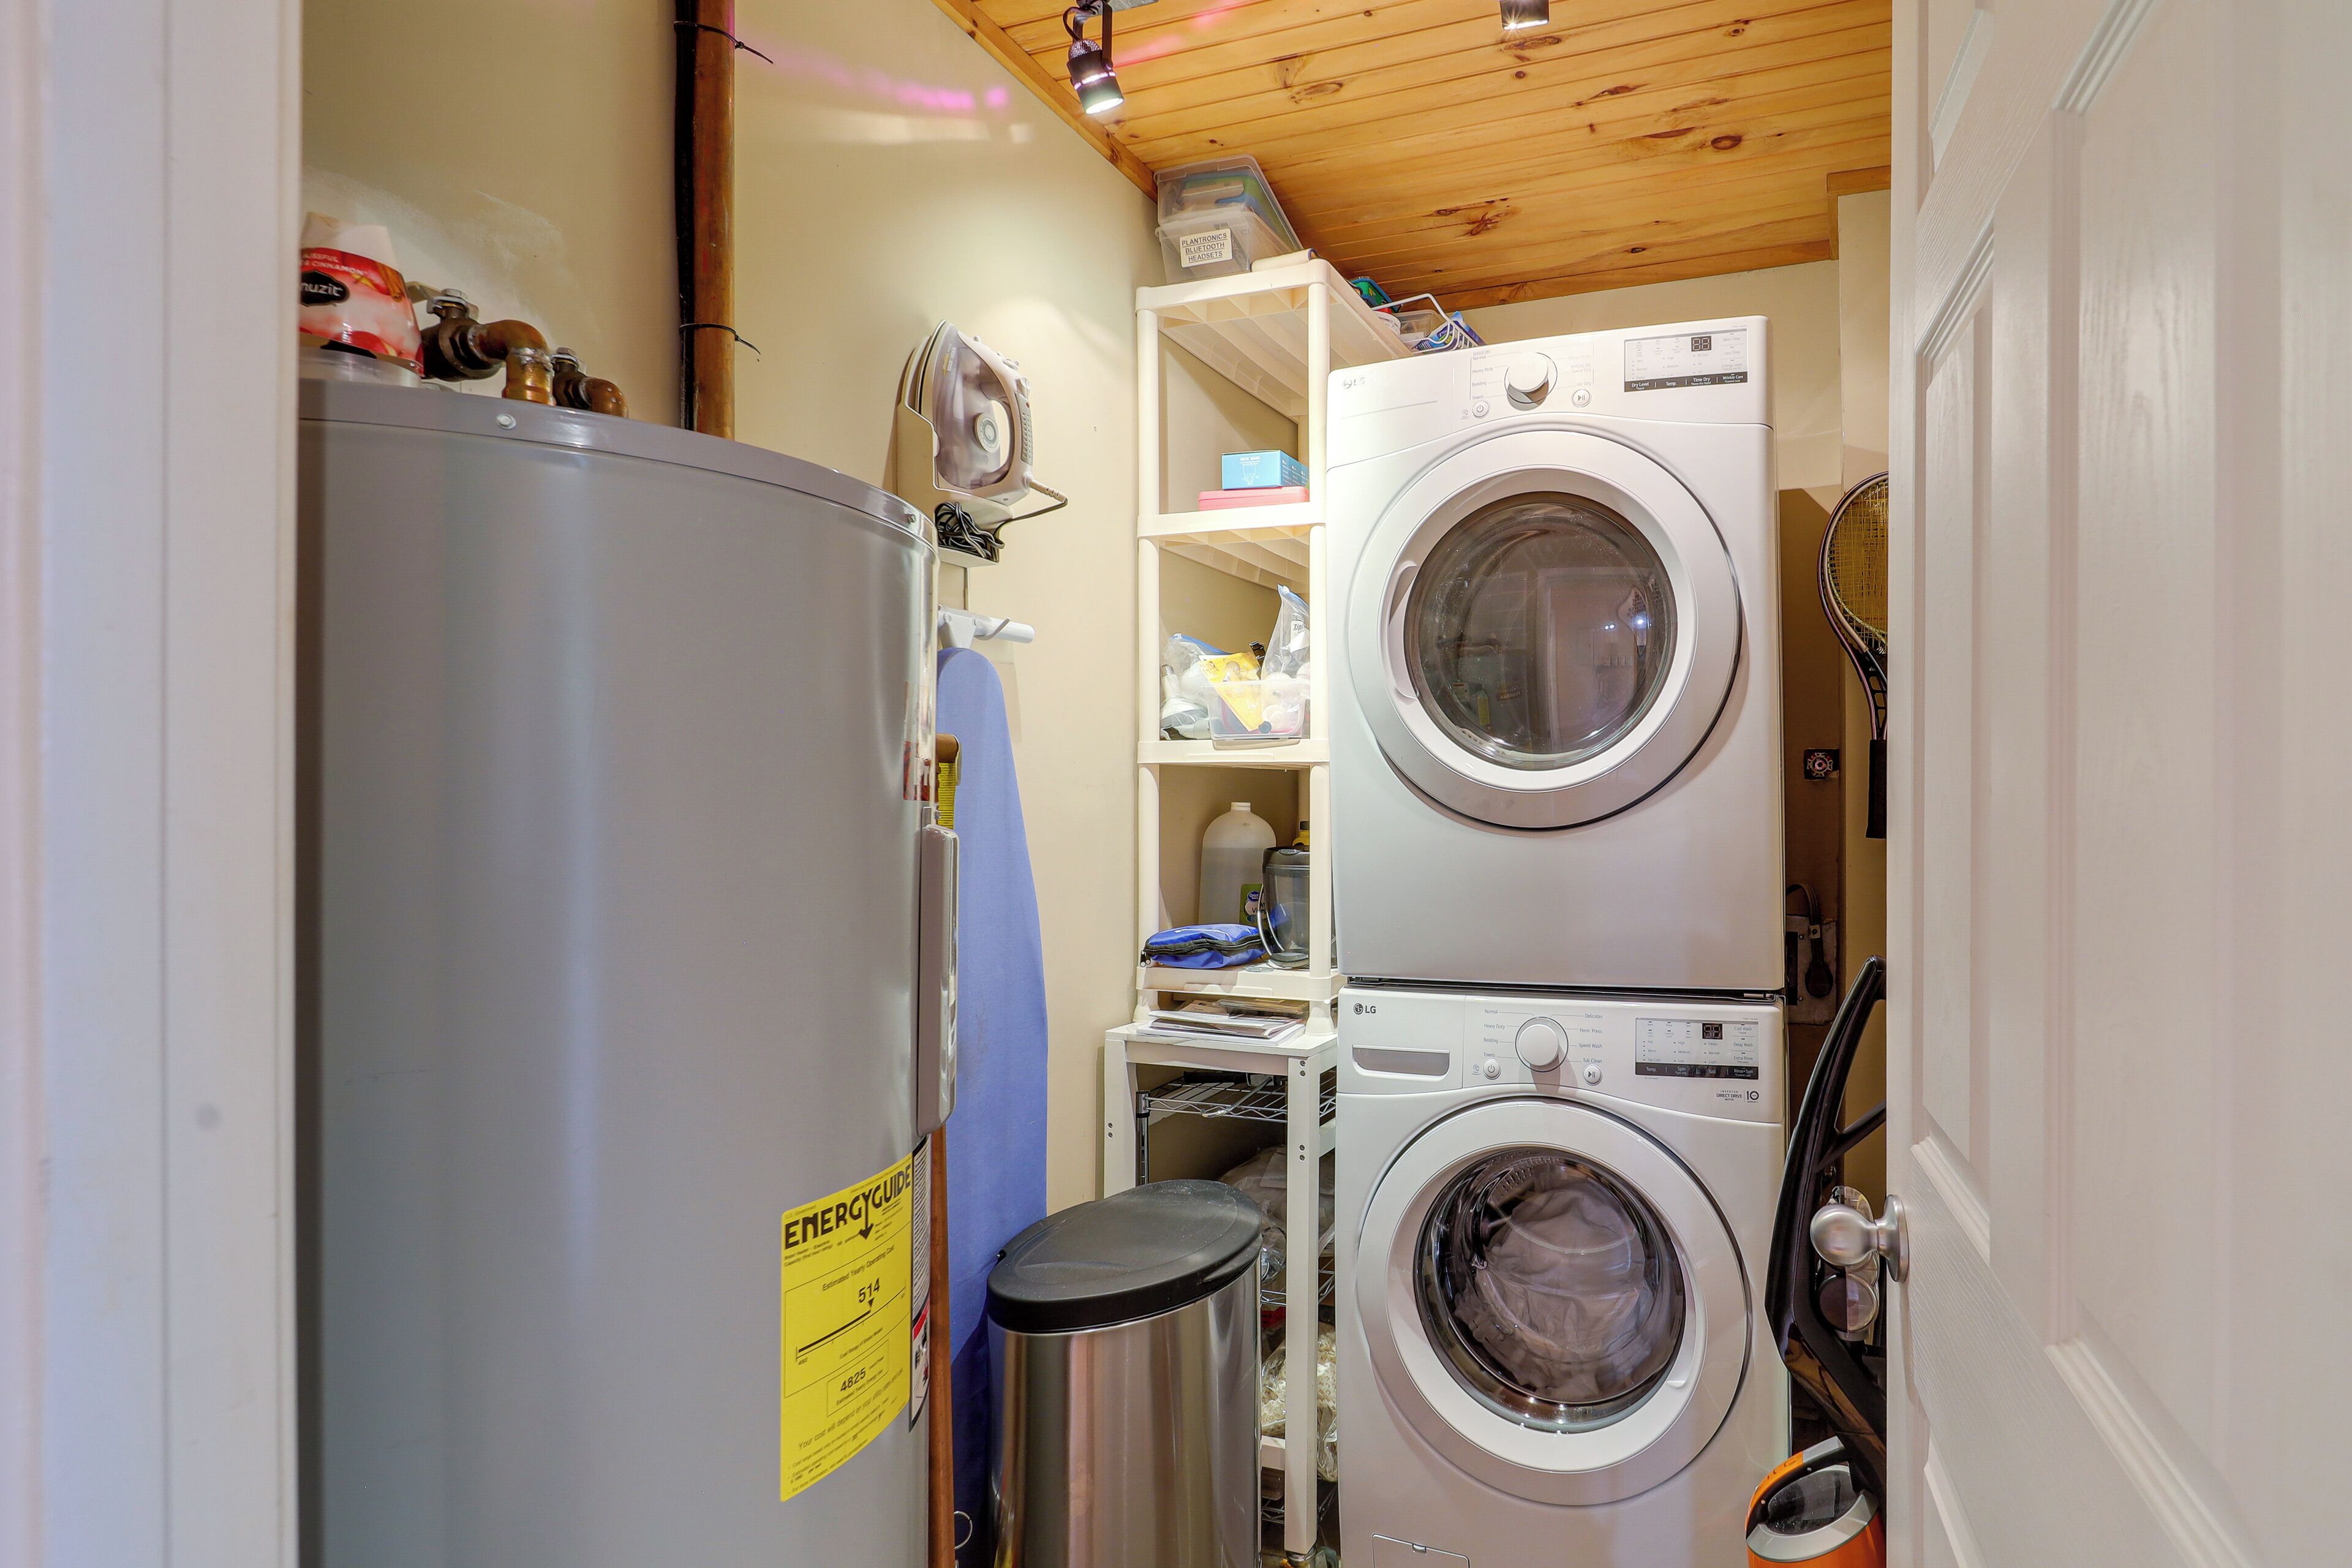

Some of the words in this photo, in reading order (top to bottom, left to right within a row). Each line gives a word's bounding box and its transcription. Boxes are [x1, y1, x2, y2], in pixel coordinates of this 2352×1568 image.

[1182, 233, 1227, 246] PLANTRONICS
[1185, 241, 1225, 254] BLUETOOTH
[1188, 251, 1223, 262] HEADSETS
[1365, 1005, 1376, 1014] LG
[1746, 1091, 1759, 1101] 10
[785, 1163, 911, 1250] ENERGYGUIDE
[823, 1272, 850, 1291] Estimated
[851, 1265, 865, 1276] Yearly
[866, 1252, 886, 1268] Operating
[858, 1278, 880, 1303] 514
[840, 1367, 866, 1392] 4825
[799, 1437, 813, 1450] Your
[814, 1430, 827, 1441] cost
[827, 1421, 836, 1433] will
[837, 1410, 855, 1428] depend
[856, 1406, 862, 1414] on
